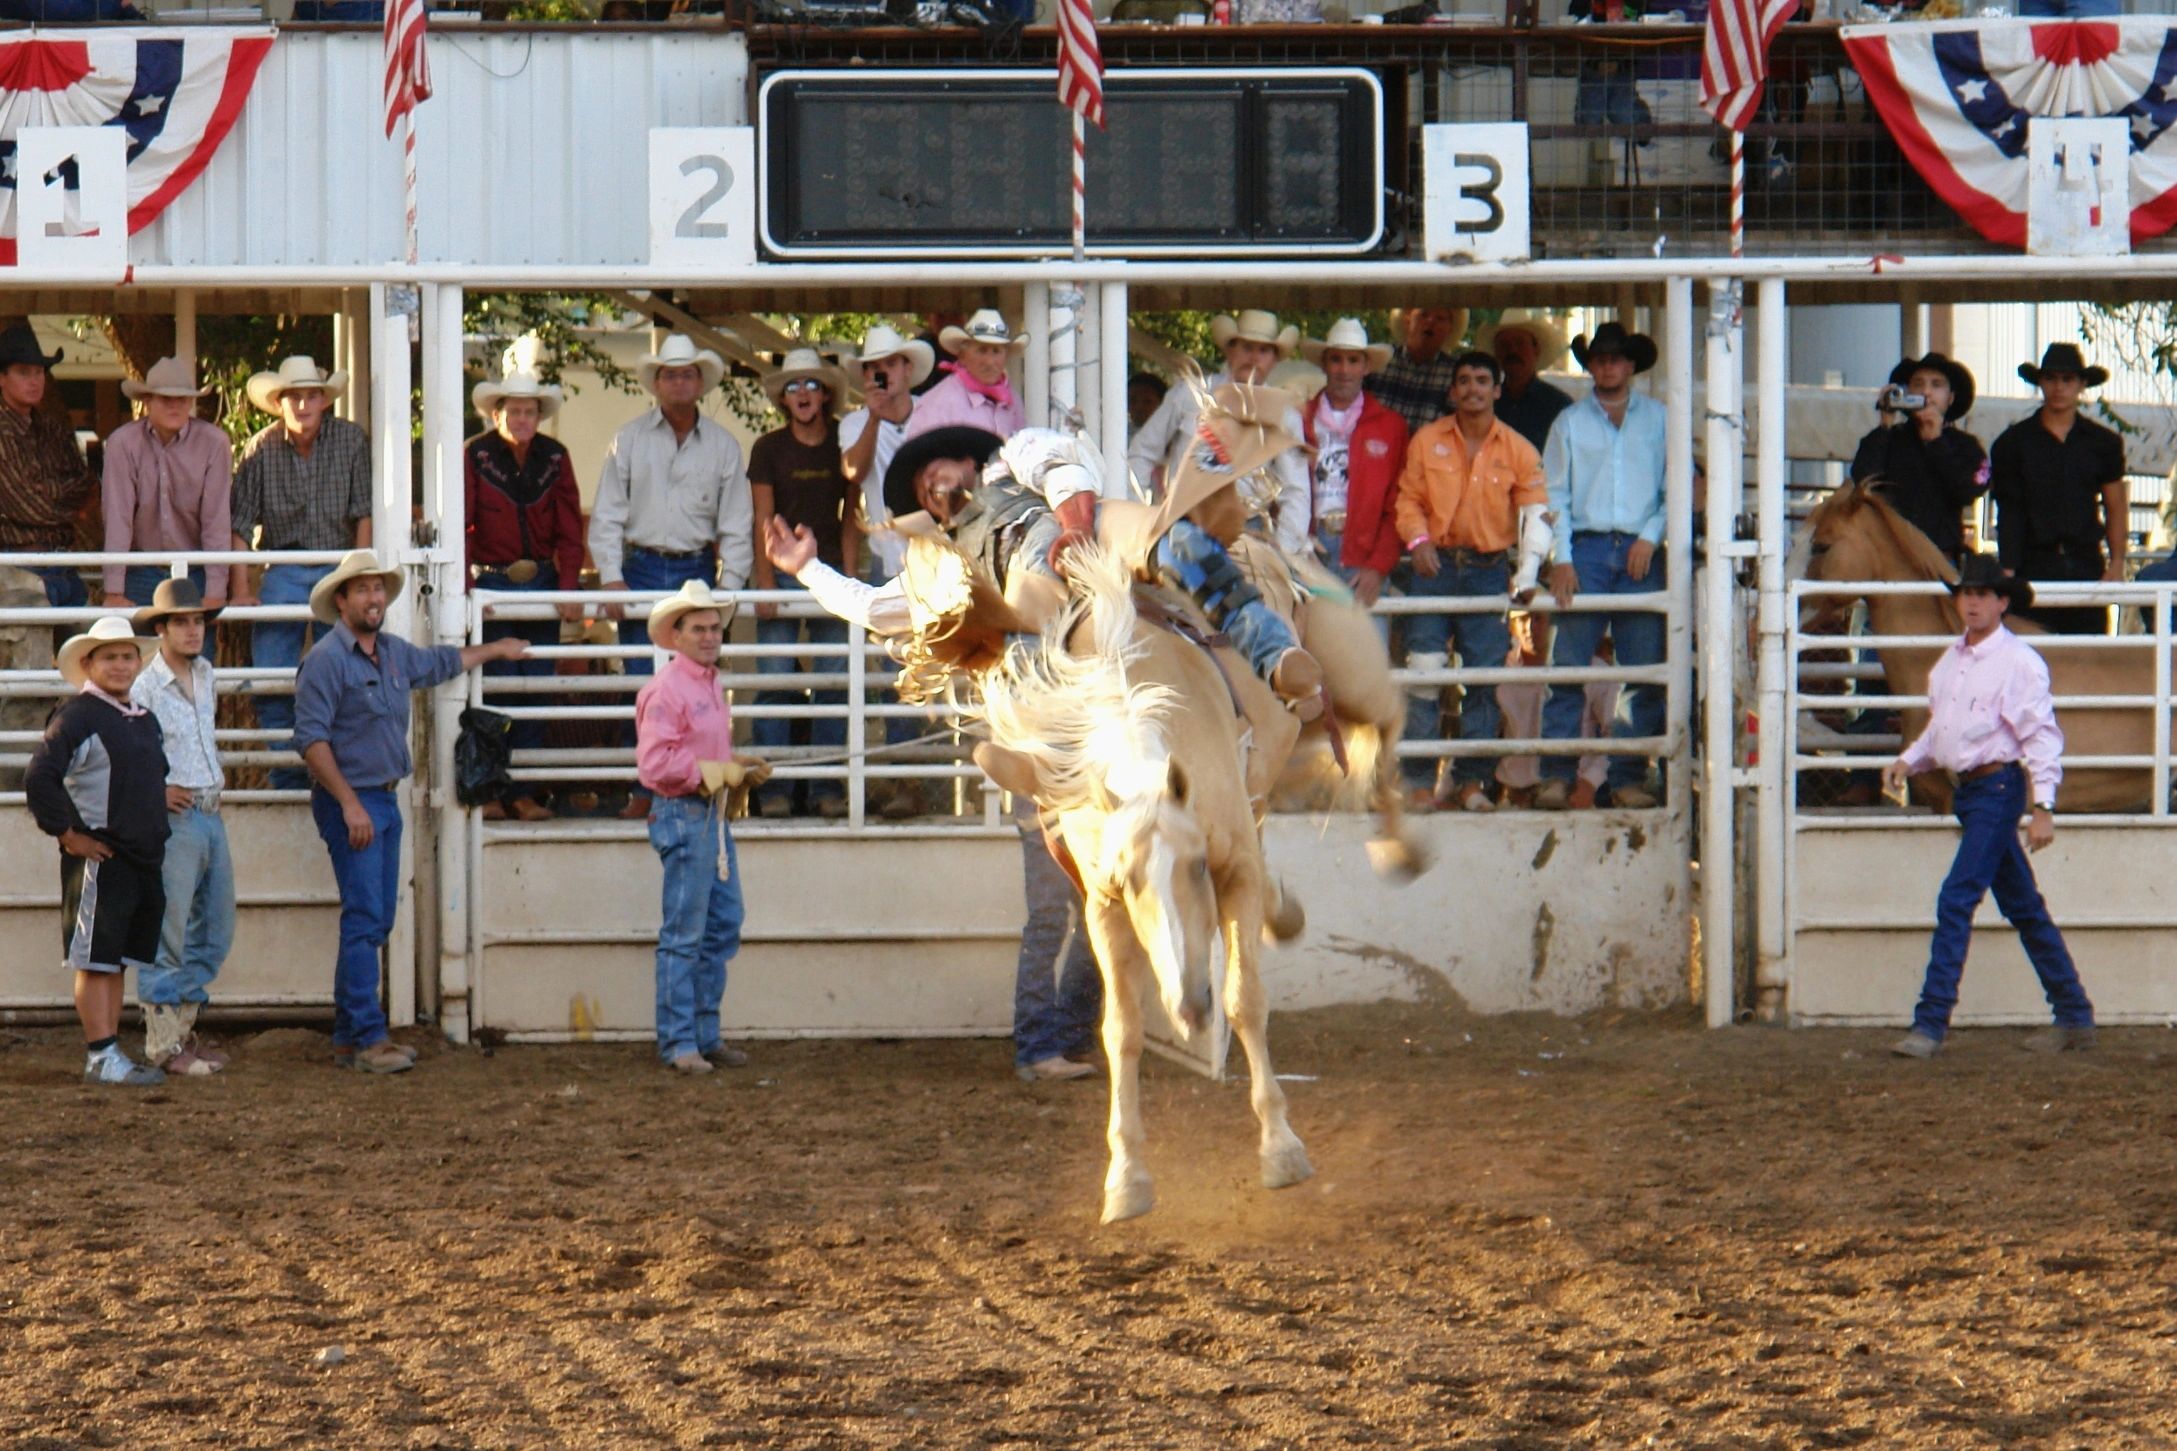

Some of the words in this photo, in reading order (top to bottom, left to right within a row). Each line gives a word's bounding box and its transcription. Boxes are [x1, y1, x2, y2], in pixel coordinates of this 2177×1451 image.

[43, 153, 100, 237] 1
[675, 154, 735, 238] 2
[1454, 153, 1505, 234] 3
